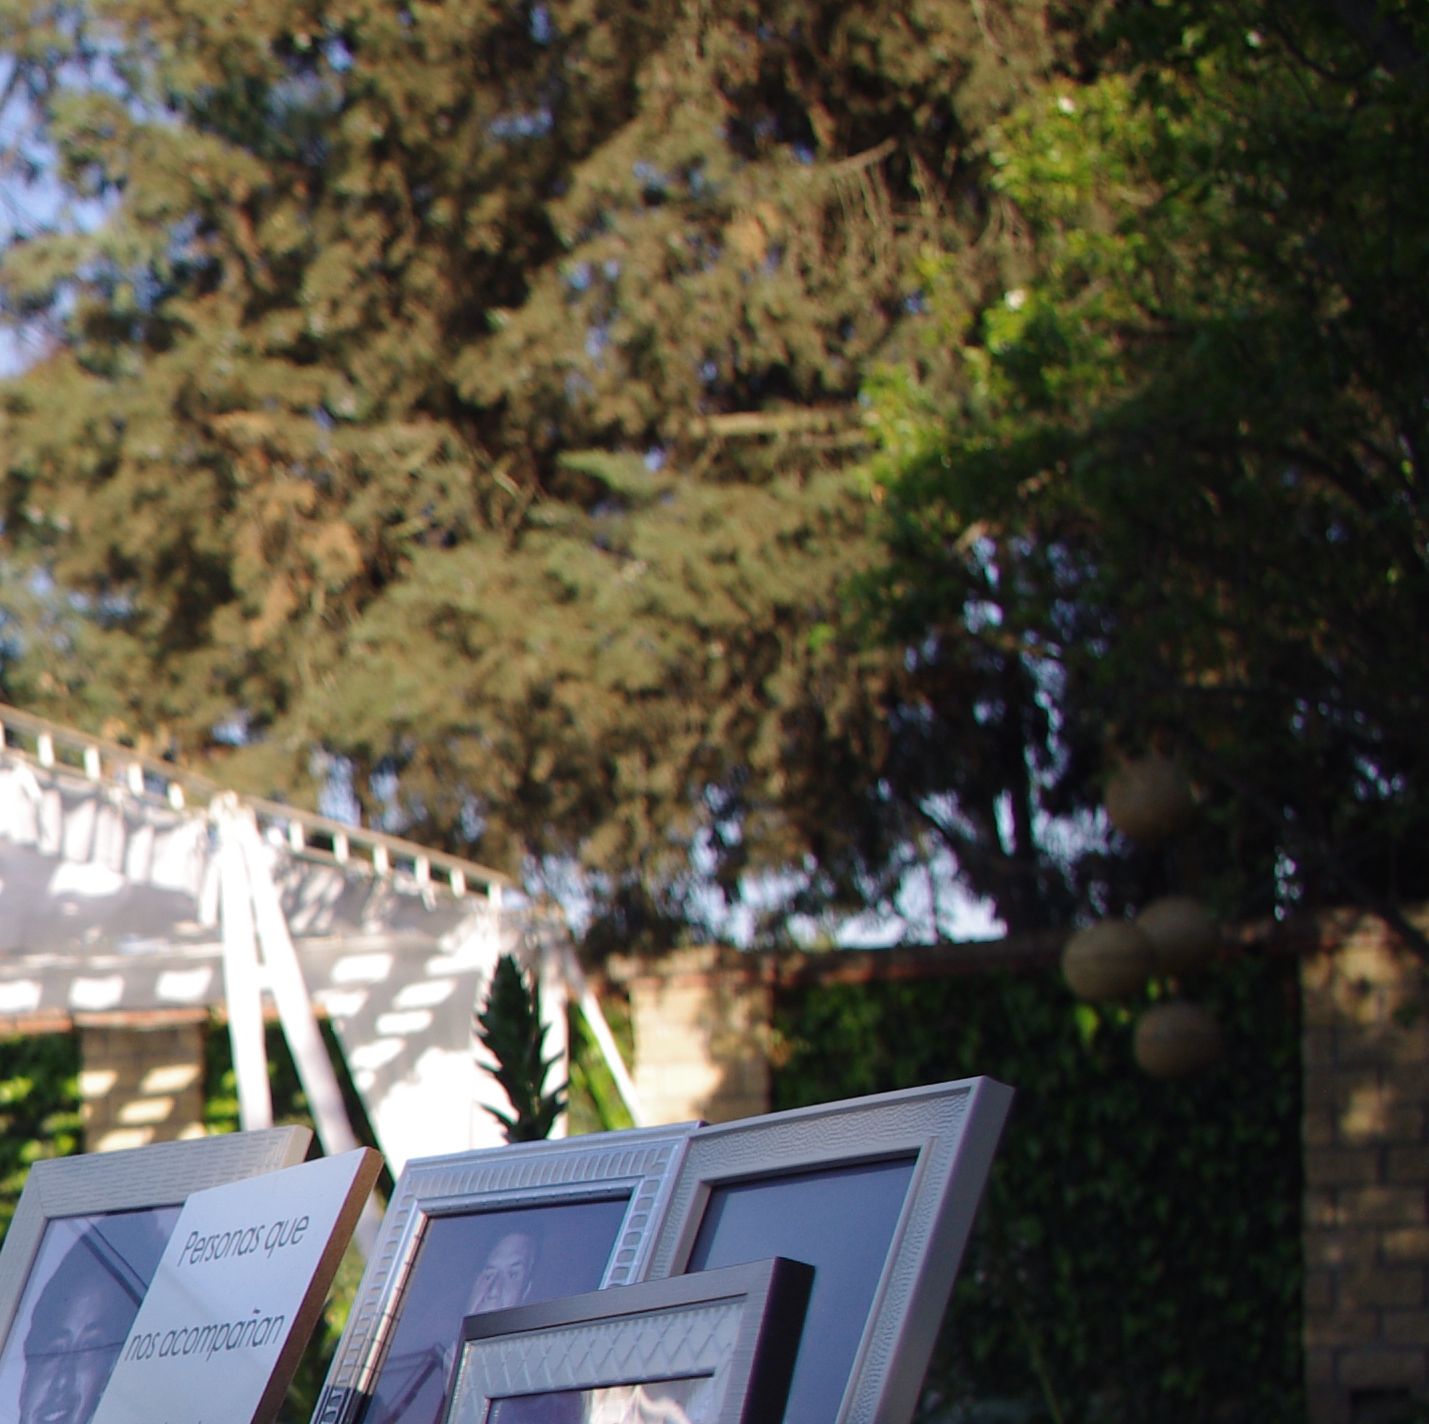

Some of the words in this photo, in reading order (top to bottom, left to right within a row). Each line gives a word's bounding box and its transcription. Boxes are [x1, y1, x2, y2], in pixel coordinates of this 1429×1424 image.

[177, 1224, 265, 1267] Personas
[265, 1215, 309, 1259] que
[124, 1331, 160, 1362] nos
[158, 1307, 285, 1362] acompañan
